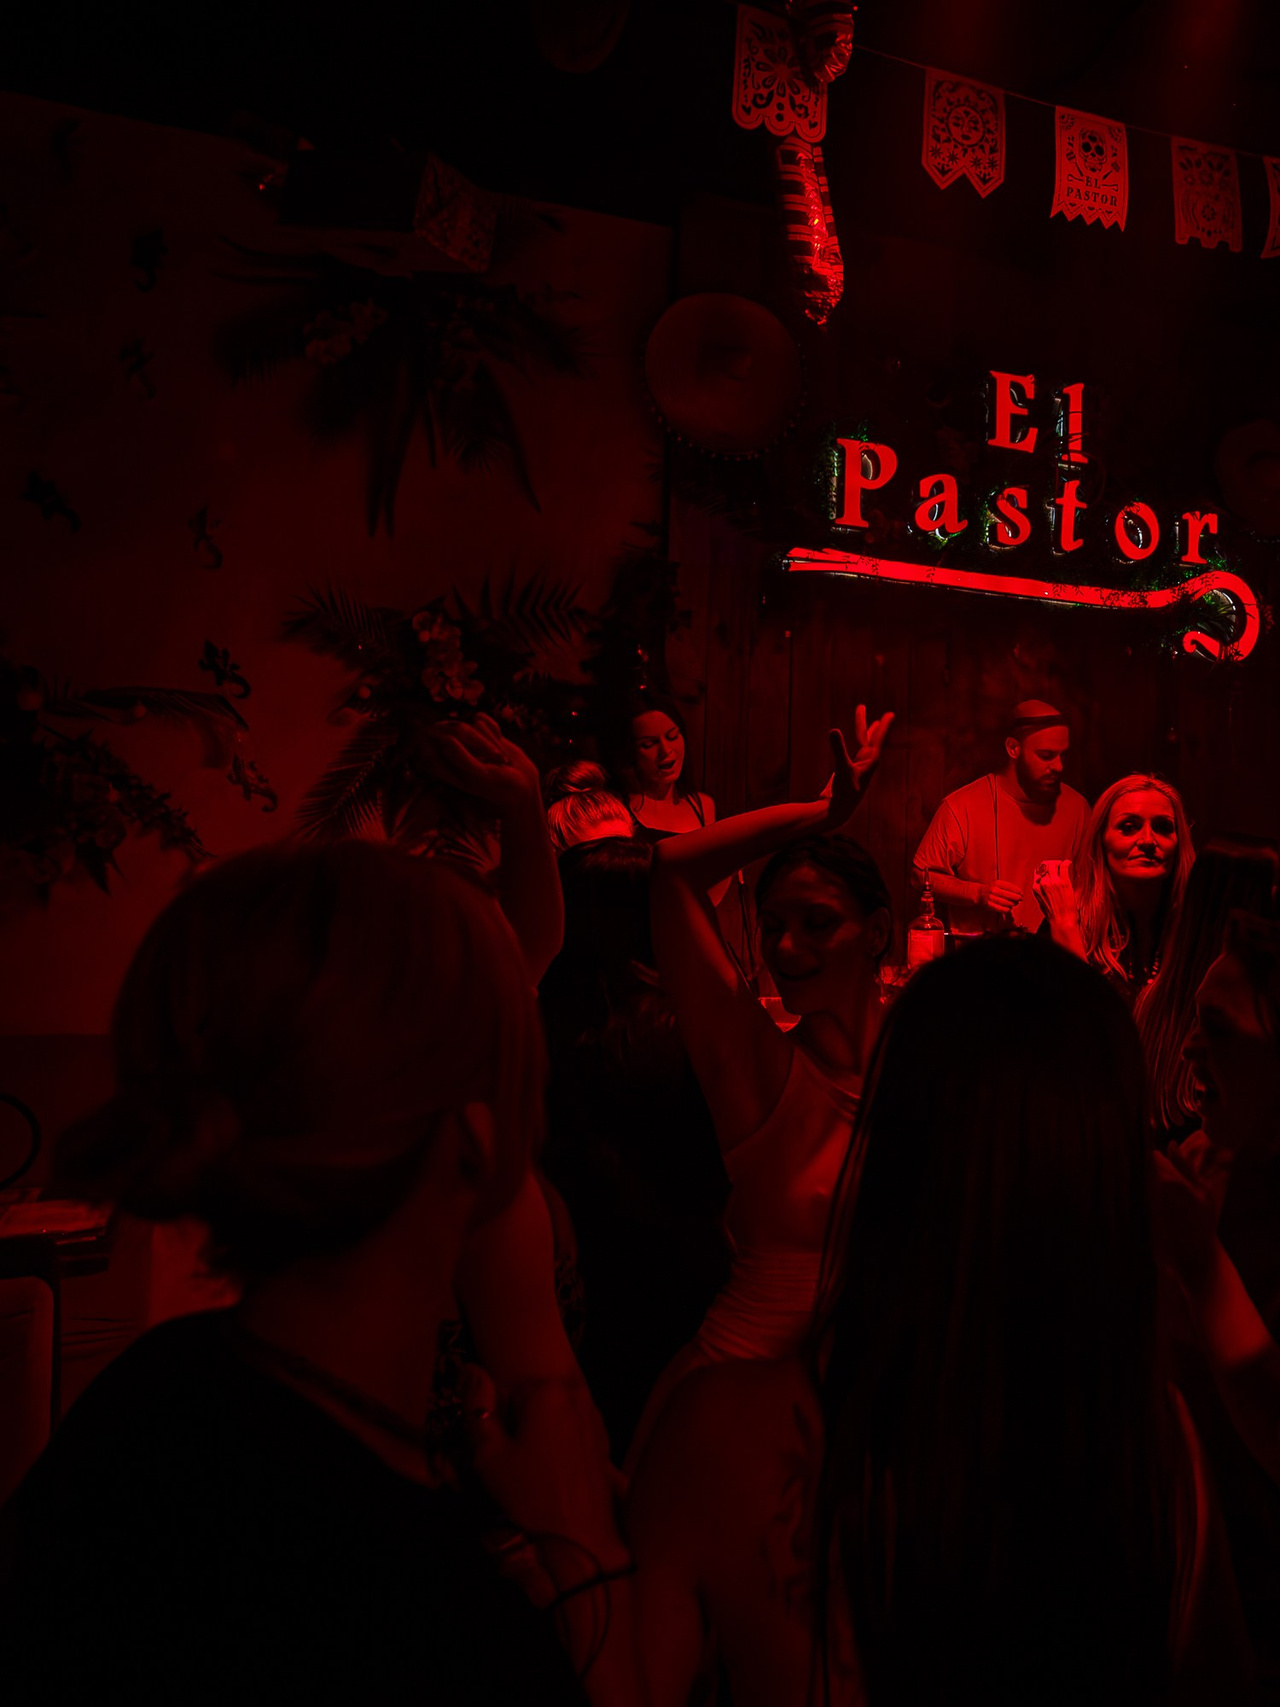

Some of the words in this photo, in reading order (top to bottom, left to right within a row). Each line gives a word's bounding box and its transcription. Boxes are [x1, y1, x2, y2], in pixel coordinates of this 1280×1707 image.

[1066, 186, 1117, 207] PASTOR
[987, 369, 1089, 464] El
[834, 437, 1218, 564] Pastor
